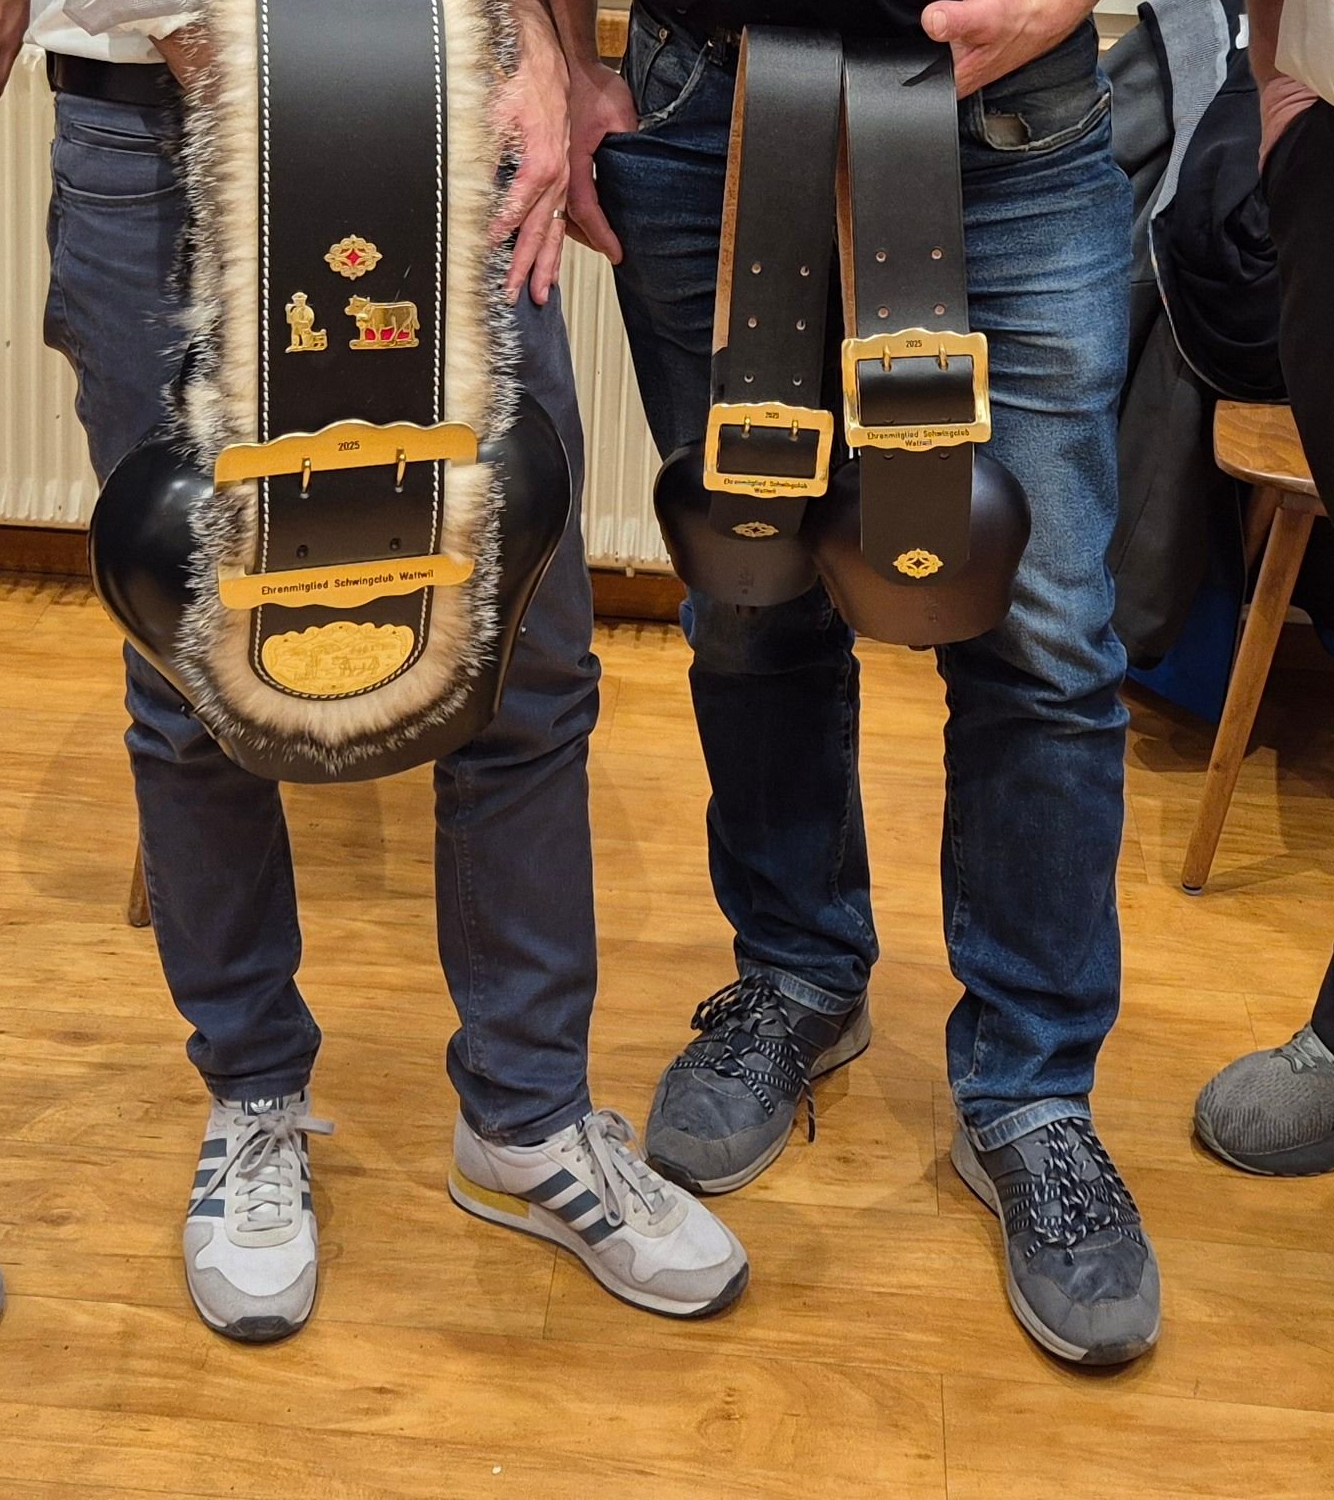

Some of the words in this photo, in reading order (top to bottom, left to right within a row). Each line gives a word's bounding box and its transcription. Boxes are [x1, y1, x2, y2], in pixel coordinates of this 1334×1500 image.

[338, 441, 360, 451] 2025
[261, 580, 328, 595] Ehrenmitglied
[334, 575, 394, 588] Schwingclub
